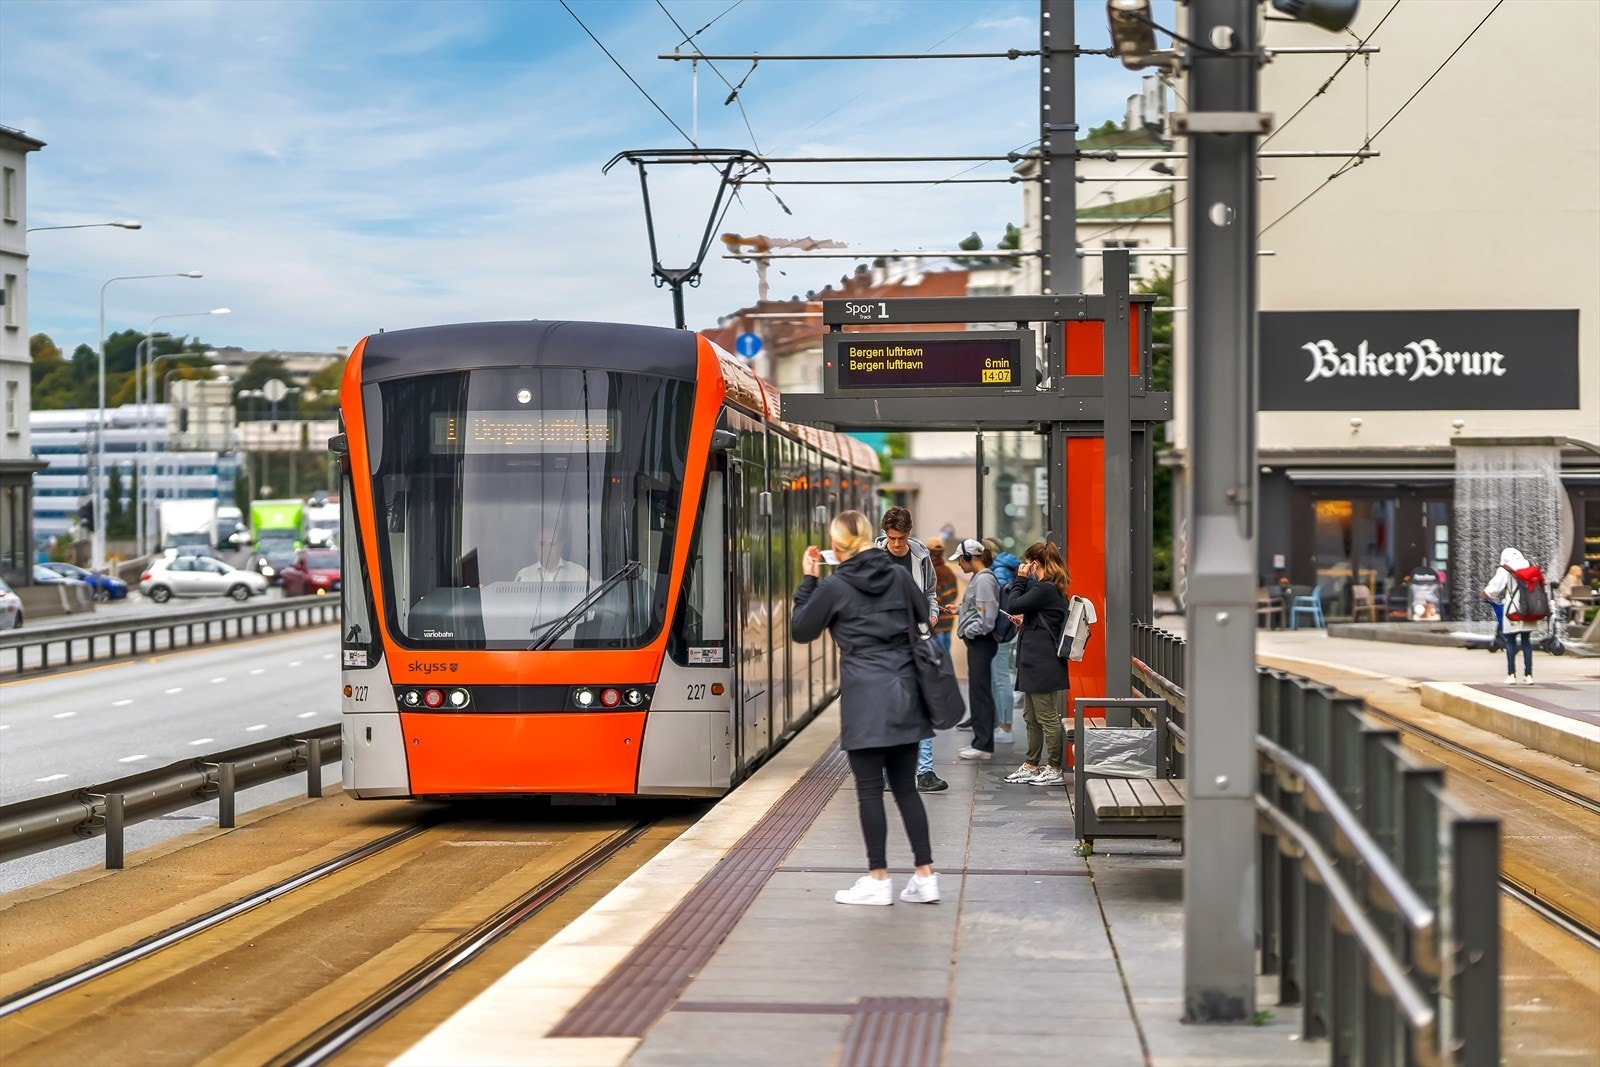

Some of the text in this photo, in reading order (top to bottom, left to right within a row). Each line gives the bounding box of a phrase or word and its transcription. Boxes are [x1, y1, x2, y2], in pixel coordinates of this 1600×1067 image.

[845, 302, 890, 319] Spor 1
[849, 346, 924, 359] Bergen lufthavn
[849, 359, 924, 372] Bergen lufthavn
[984, 371, 1010, 381] 14:07
[408, 660, 447, 674] skyss
[355, 685, 369, 702] 227
[687, 684, 706, 700] 227
